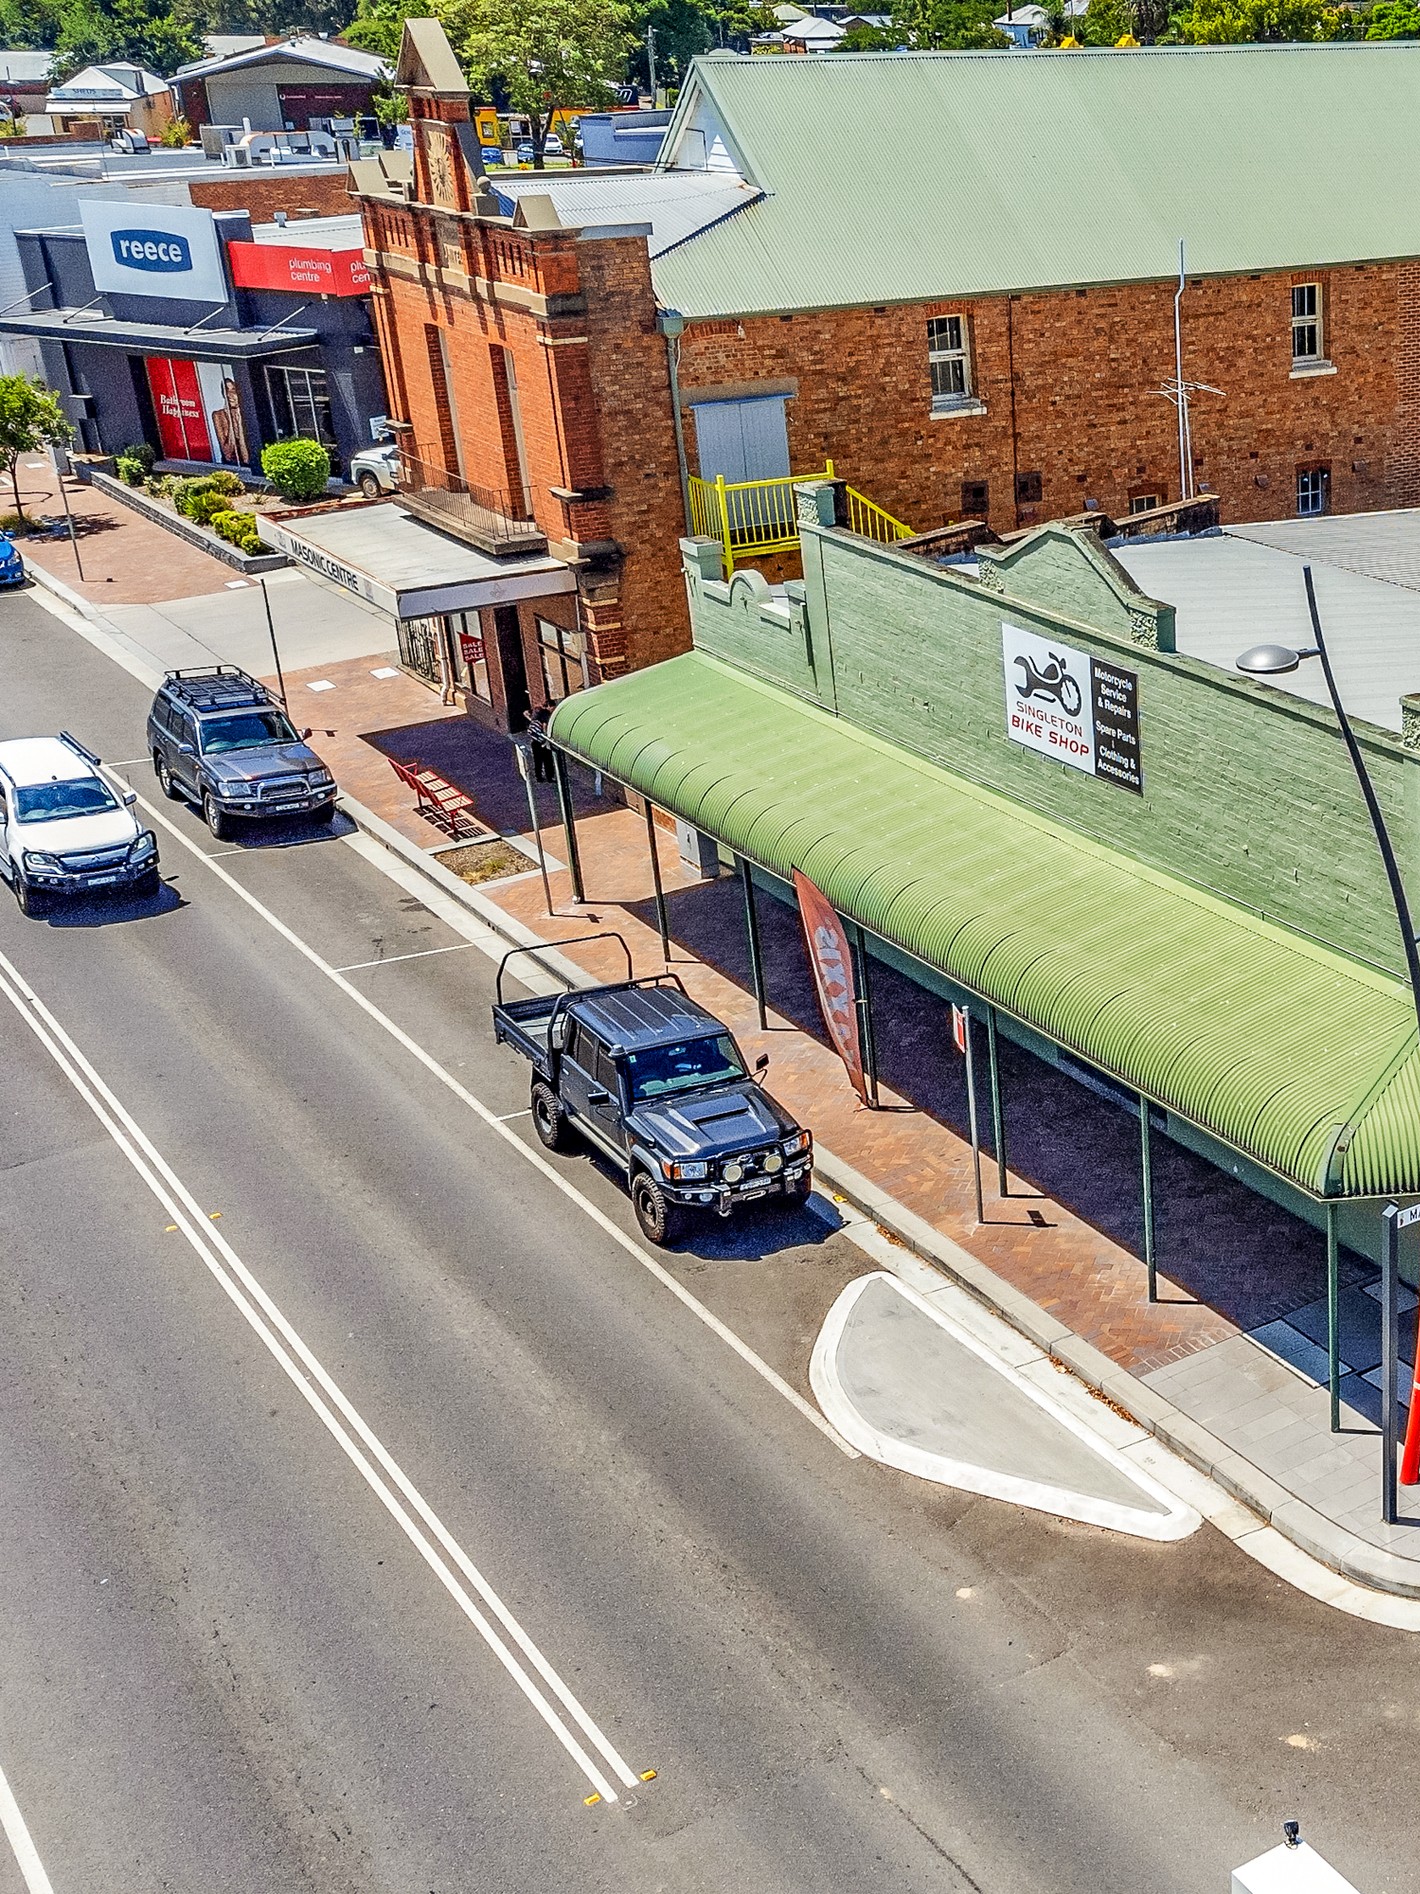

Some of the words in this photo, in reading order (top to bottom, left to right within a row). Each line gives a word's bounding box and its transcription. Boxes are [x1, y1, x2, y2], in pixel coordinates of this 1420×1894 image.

[119, 239, 182, 263] reece
[289, 258, 333, 274] plumbing
[290, 270, 321, 283] centre
[351, 271, 371, 284] cen
[290, 539, 327, 573] MASONIC
[326, 560, 359, 591] CENTRE
[462, 641, 483, 650] SALE
[463, 647, 484, 656] SALE
[464, 653, 485, 661] SALE
[1094, 667, 1133, 691] Motorcycle
[1100, 683, 1127, 703] Service
[1097, 696, 1104, 708] &
[1104, 699, 1132, 719] Repairs
[1016, 701, 1083, 738] SINGLETON
[1011, 714, 1043, 738] BIKE
[1048, 730, 1090, 756] SHOP
[1095, 720, 1117, 738] Spare
[1117, 728, 1136, 746] Parts
[1099, 745, 1129, 769] Clothing
[1130, 758, 1137, 770] &
[1097, 758, 1140, 786] Accessories
